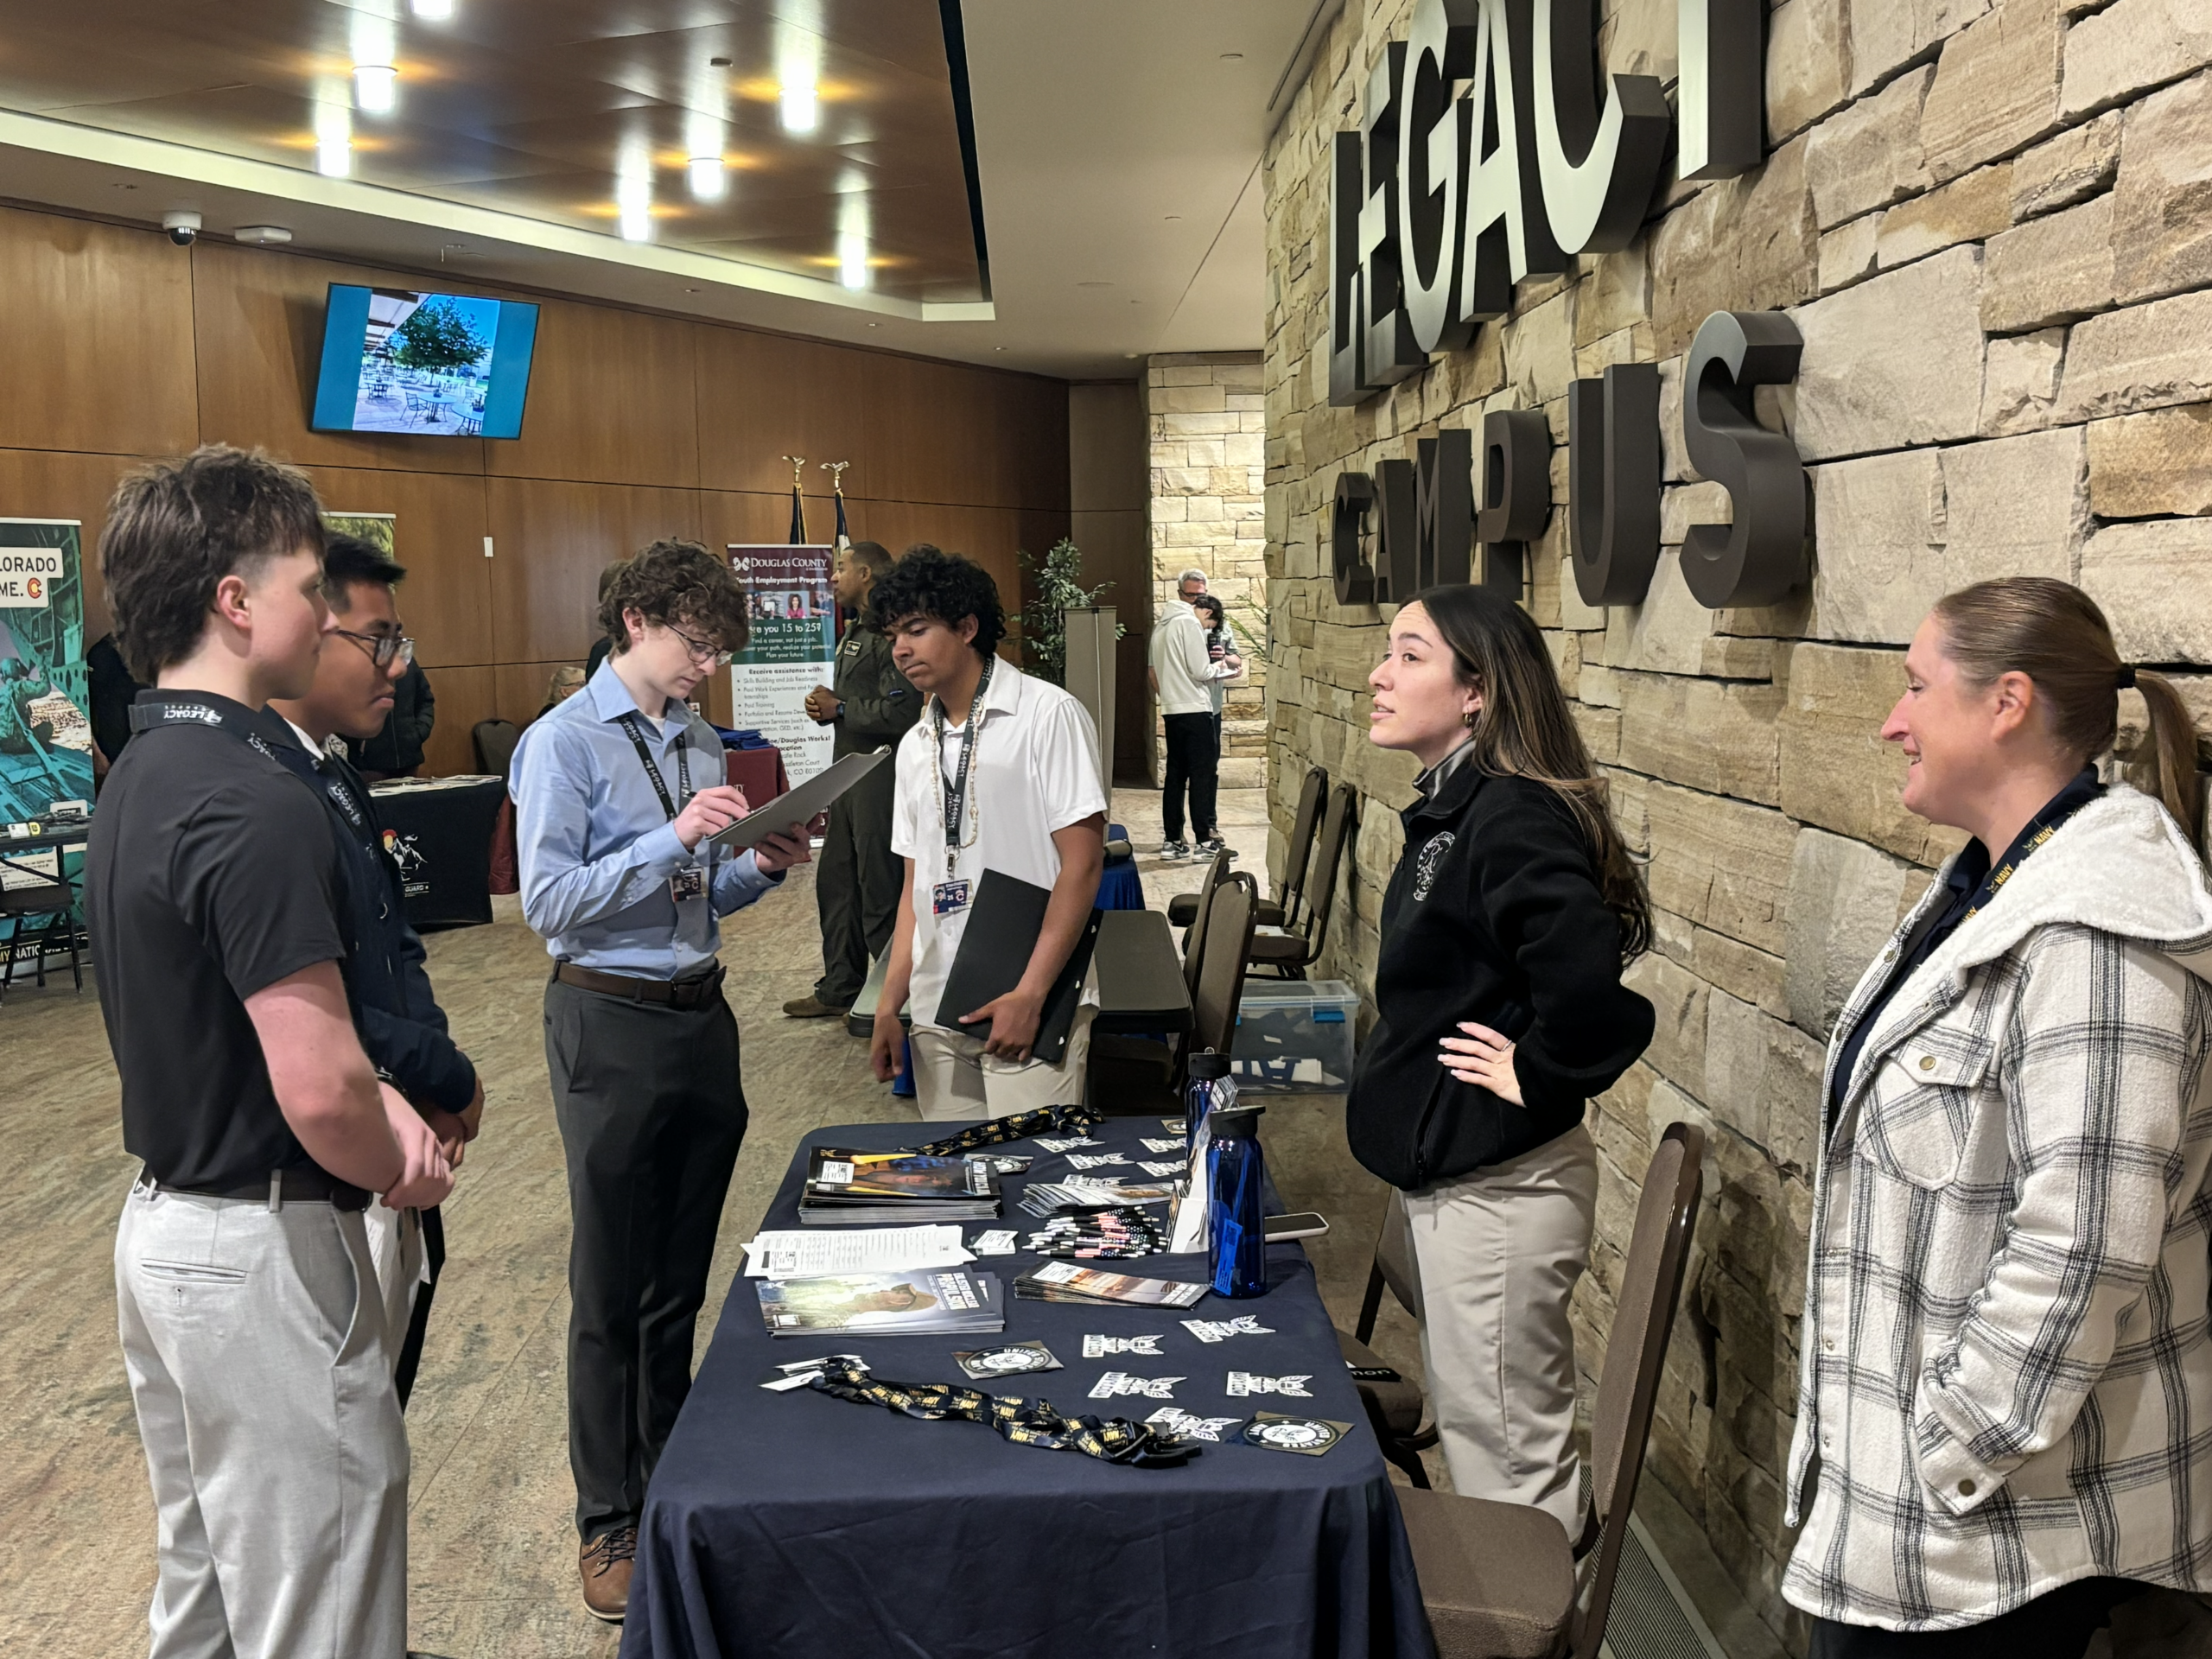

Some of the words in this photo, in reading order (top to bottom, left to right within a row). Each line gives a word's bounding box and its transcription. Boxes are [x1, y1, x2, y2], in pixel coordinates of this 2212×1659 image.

[1332, 310, 1805, 608] CAMPUS
[0, 556, 56, 572] ORADO
[750, 557, 790, 568] DOUGLAS
[791, 557, 827, 568] COUNTY
[755, 576, 798, 585] Employment
[798, 576, 828, 585] Program
[764, 626, 779, 635] you
[782, 623, 792, 632] 15
[795, 624, 804, 632] to
[804, 622, 822, 632] 25?
[163, 709, 206, 720] LEGACY
[2034, 825, 2055, 845] NAVY
[1994, 863, 2013, 885] NAVY
[959, 1399, 979, 1409] NAVY
